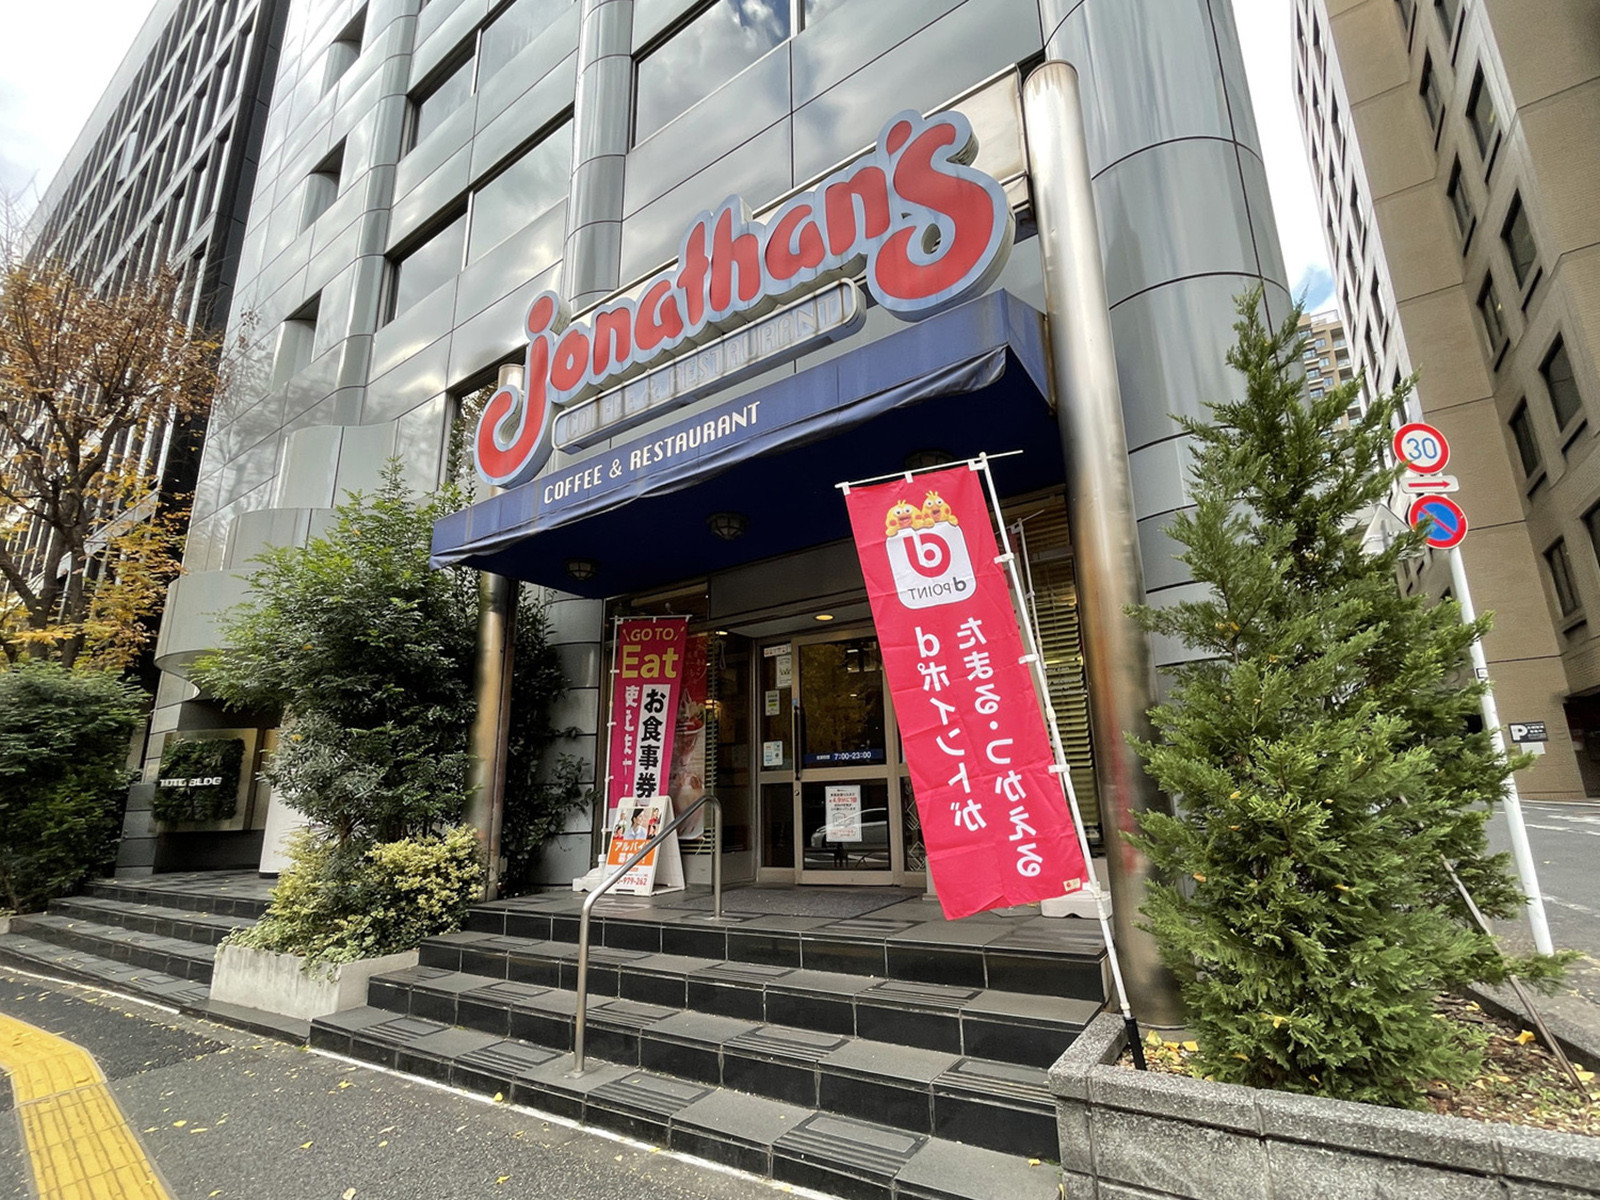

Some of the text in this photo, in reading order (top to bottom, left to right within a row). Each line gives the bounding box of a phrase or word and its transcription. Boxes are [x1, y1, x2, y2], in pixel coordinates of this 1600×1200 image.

[544, 401, 761, 505] COFFEE & RESTAURANT
[1406, 437, 1438, 461] 30
[630, 627, 674, 642] GO TO
[622, 644, 679, 679] Eat
[635, 688, 667, 799] お食事券
[833, 750, 872, 761] 7:00-23:00
[614, 840, 649, 853] アルバイ
